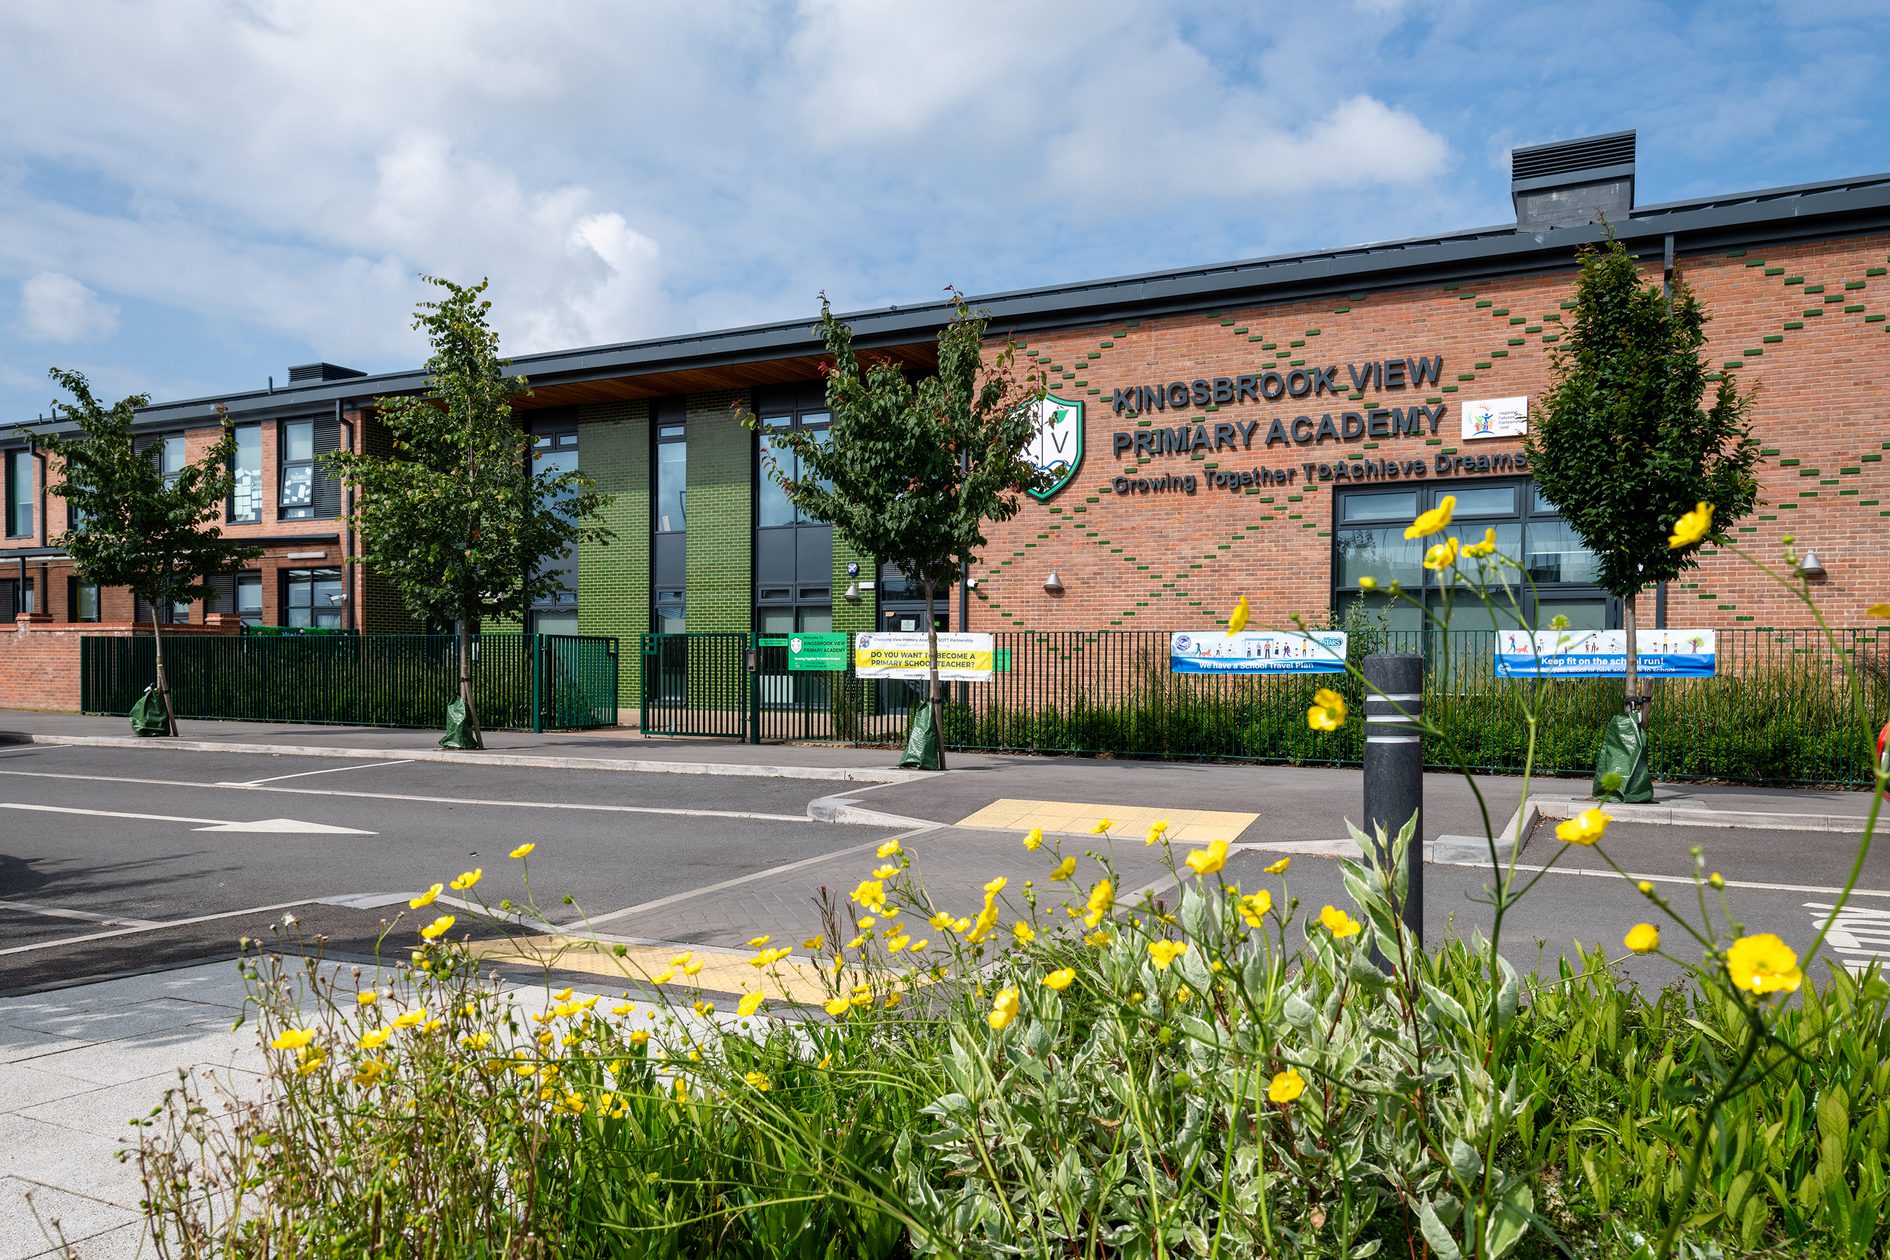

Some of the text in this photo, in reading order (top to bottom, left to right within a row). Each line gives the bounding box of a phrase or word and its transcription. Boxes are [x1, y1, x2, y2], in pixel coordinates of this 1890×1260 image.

[1113, 355, 1442, 413] KINGSBROOK VIEW
[1051, 431, 1069, 453] V
[1113, 404, 1446, 457] PRIMARY ACADEMY
[1112, 473, 1197, 494] Growing
[1203, 465, 1296, 489] Together
[1435, 452, 1528, 473] Dreams
[1541, 657, 1565, 666] Keep
[1567, 657, 1576, 665] fit
[1593, 657, 1608, 665] the
[1610, 657, 1642, 665] schl
[1644, 657, 1664, 665] run!
